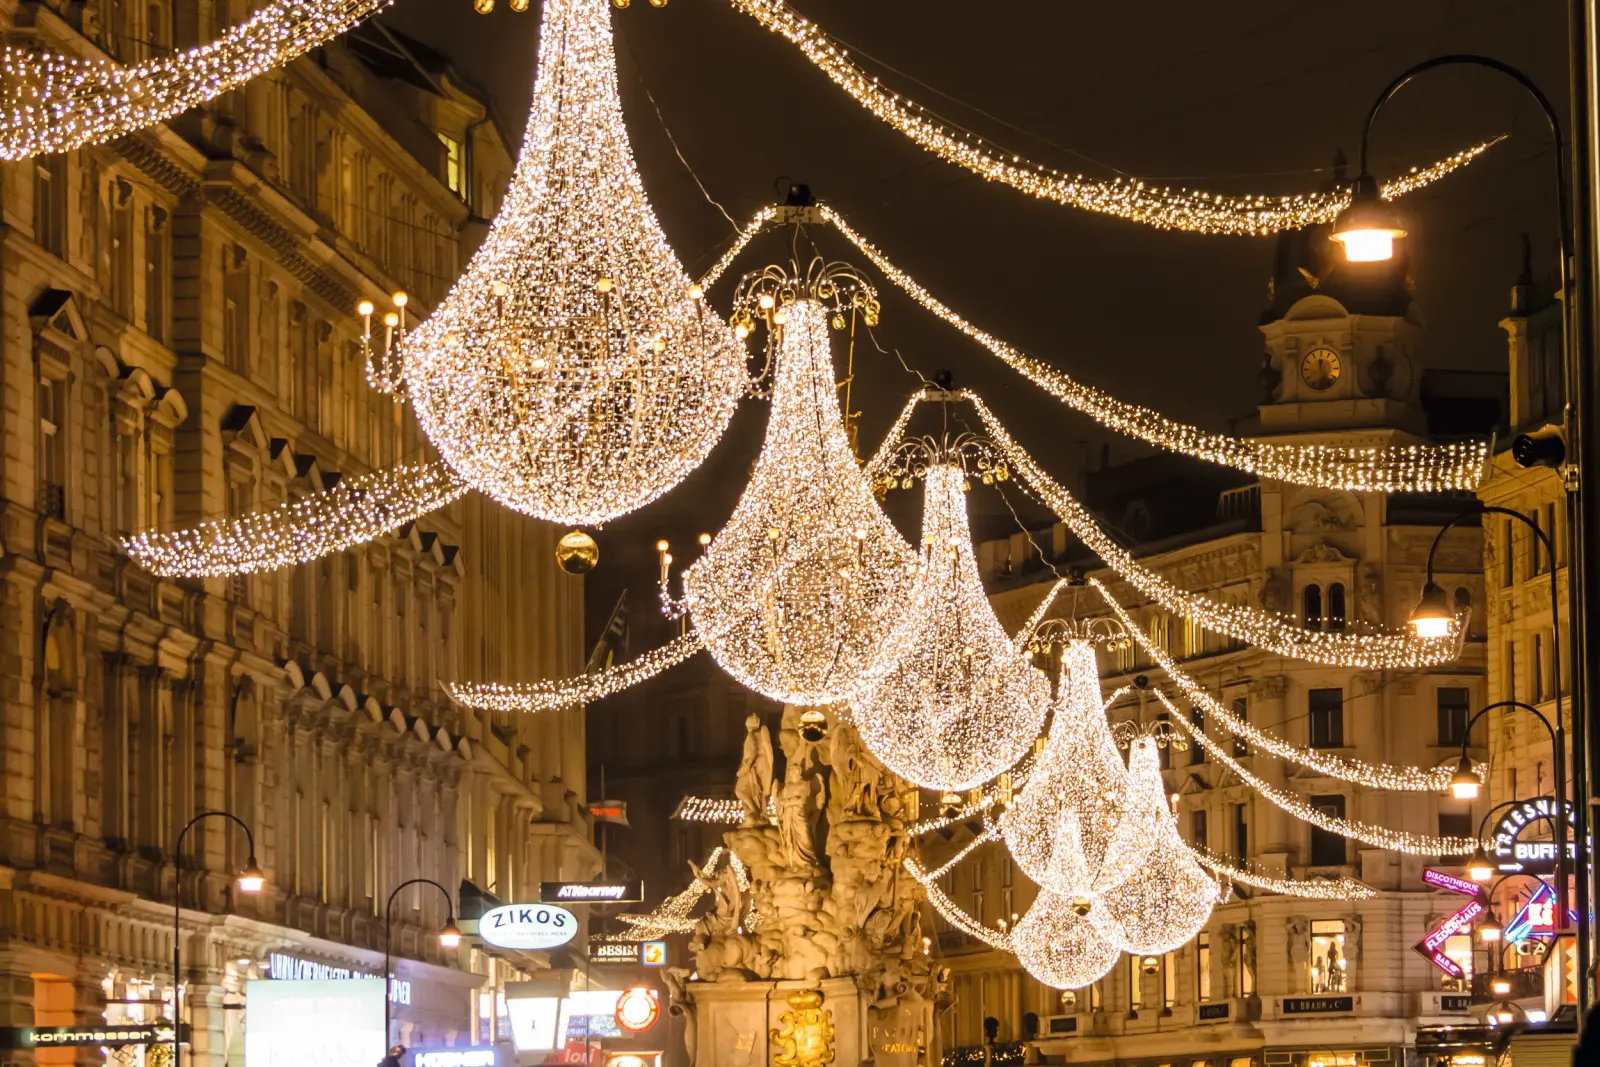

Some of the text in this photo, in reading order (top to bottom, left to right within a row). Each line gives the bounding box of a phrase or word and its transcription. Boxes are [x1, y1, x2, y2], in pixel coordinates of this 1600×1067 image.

[1425, 870, 1480, 892] DISCOTHEQUE
[492, 909, 566, 928] ZIKOS
[1425, 902, 1482, 951] FLEDERMAUS
[1435, 953, 1451, 967] BAR
[29, 1031, 152, 1042] kornmesser
